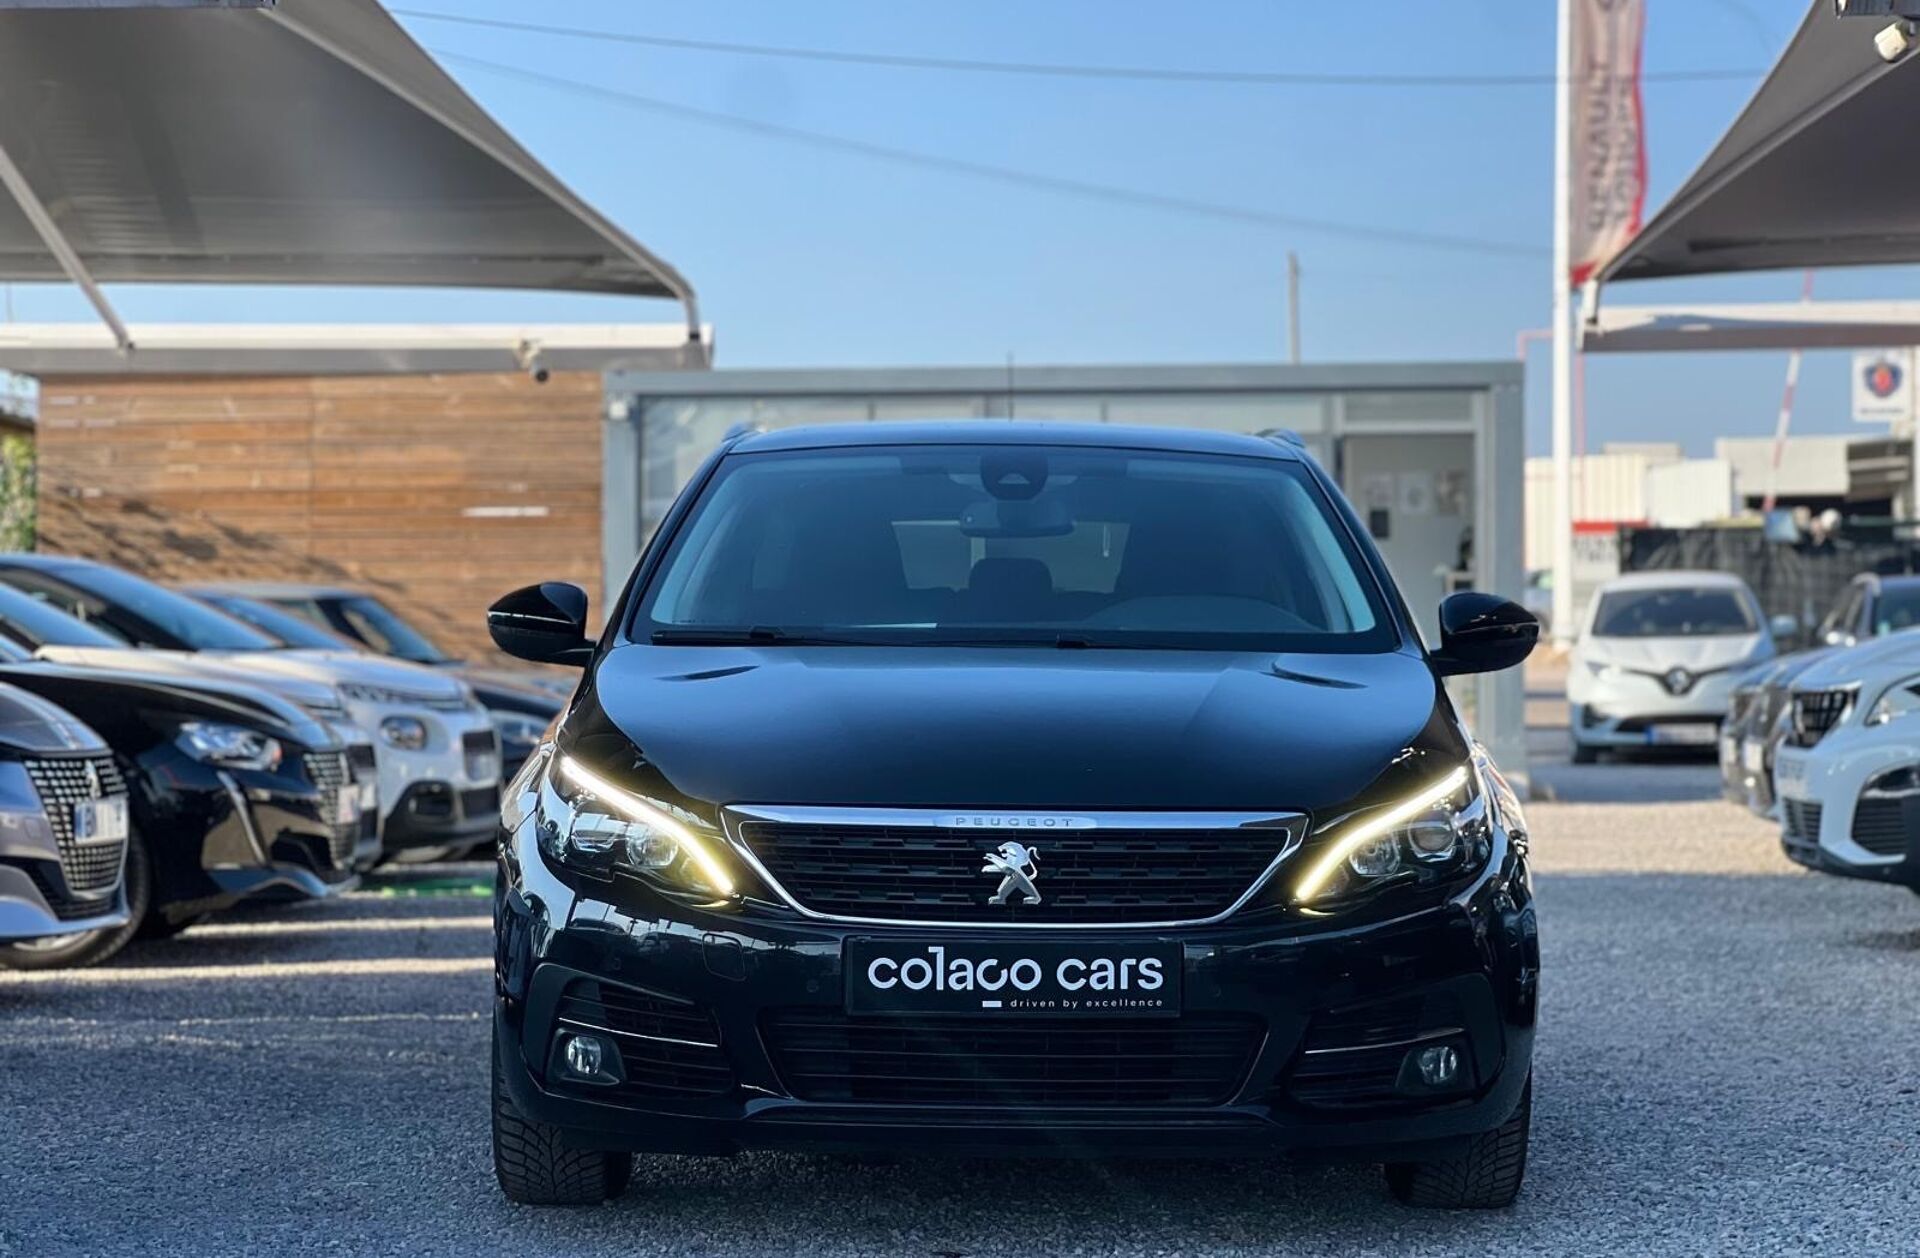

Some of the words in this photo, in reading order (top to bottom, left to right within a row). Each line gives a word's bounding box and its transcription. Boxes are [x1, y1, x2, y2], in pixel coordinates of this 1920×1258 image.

[955, 816, 1073, 827] PEUGEOT
[1056, 958, 1164, 990] cars
[1010, 999, 1055, 1007] driven
[1063, 999, 1078, 1009] by
[1086, 999, 1163, 1007] excellence
